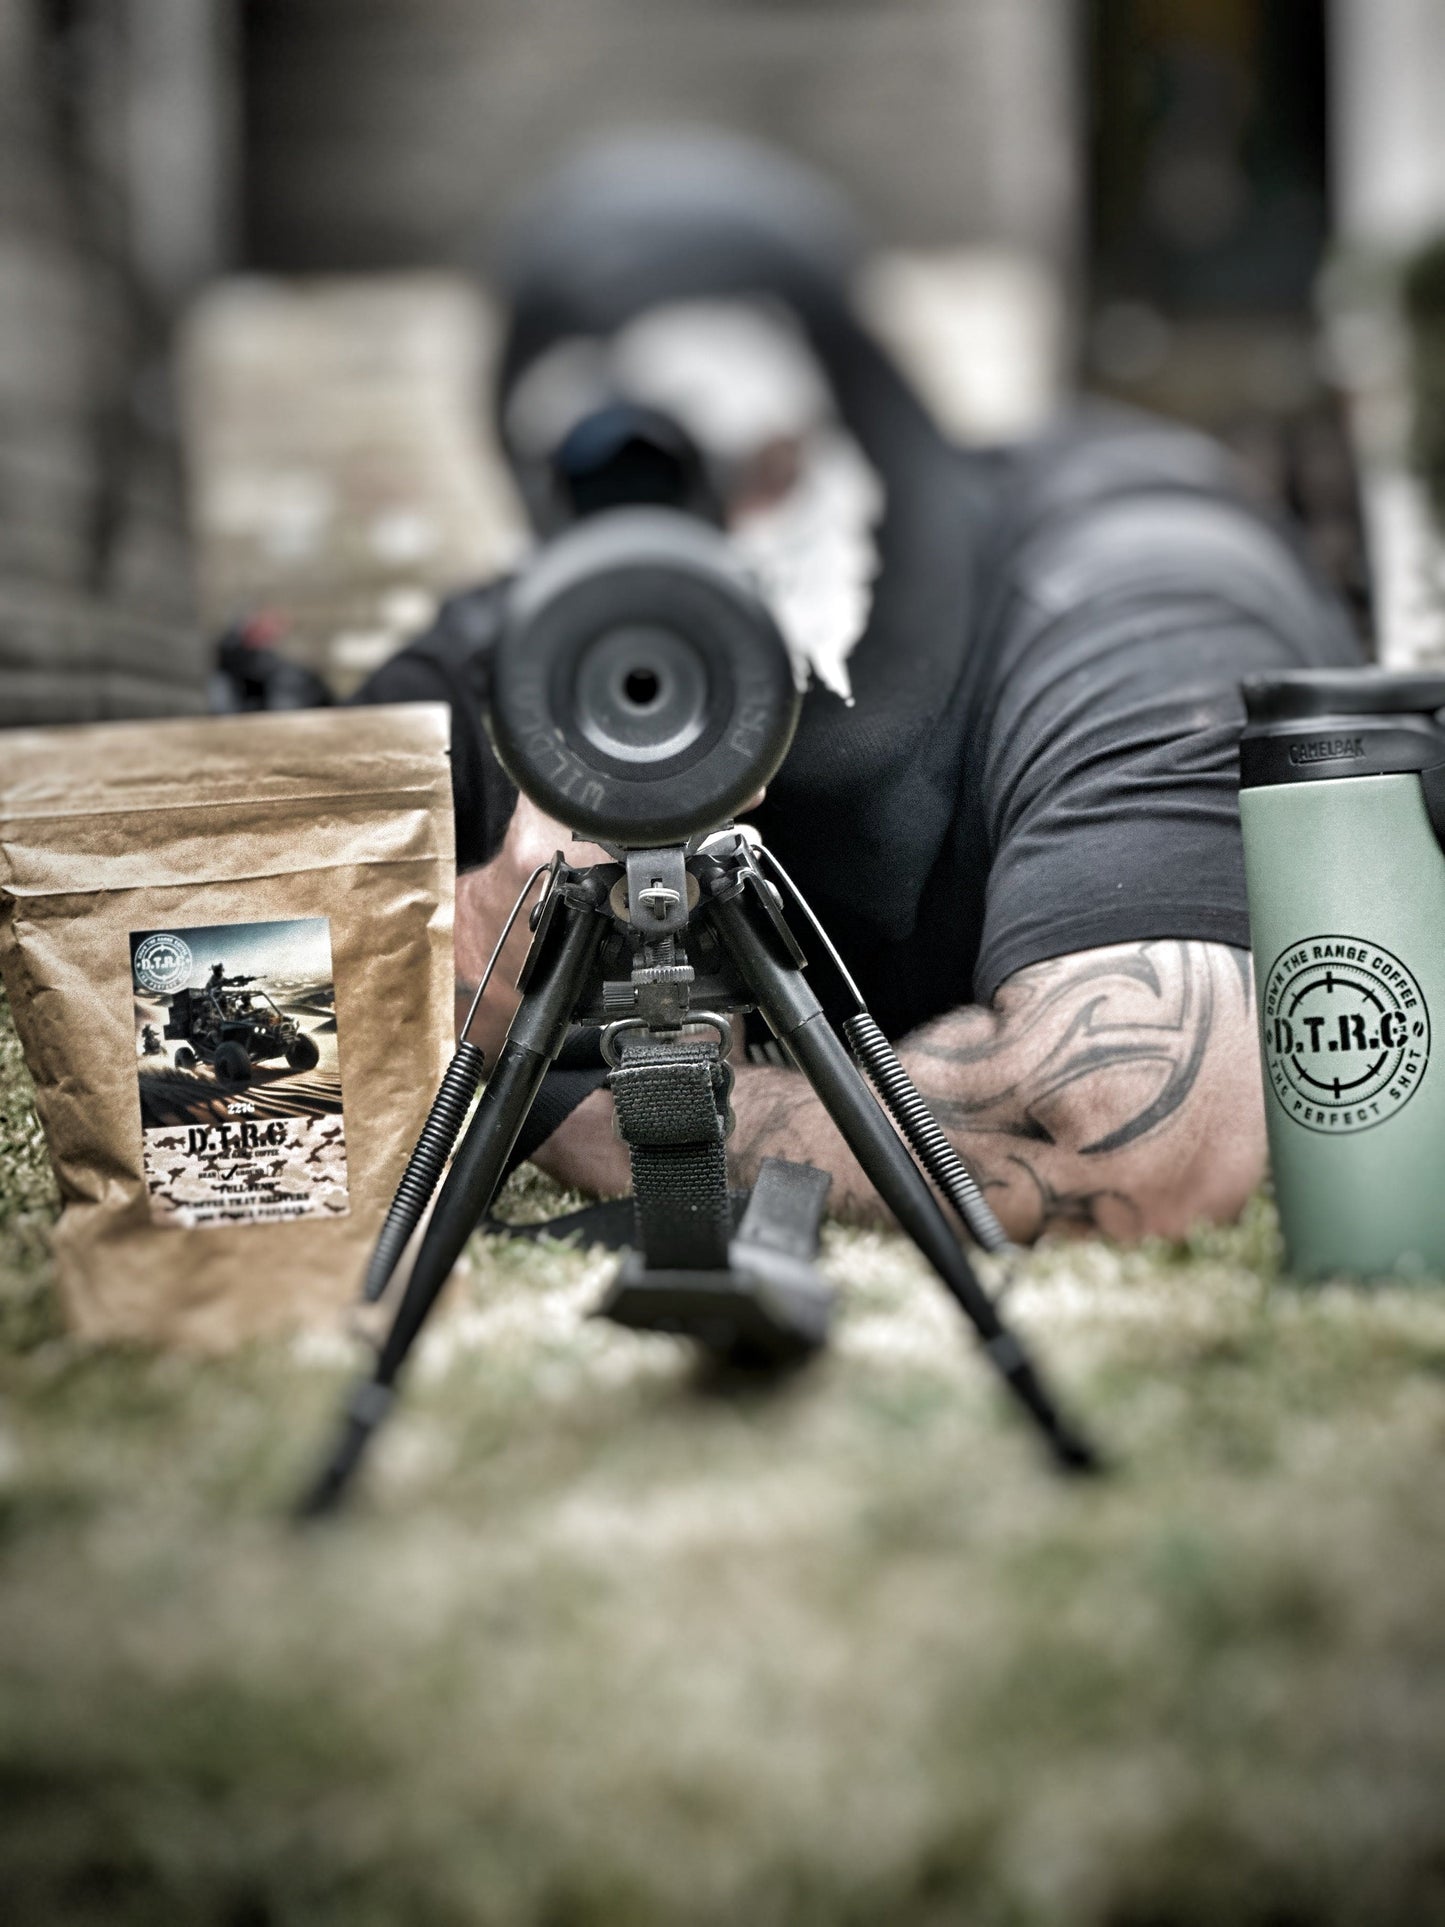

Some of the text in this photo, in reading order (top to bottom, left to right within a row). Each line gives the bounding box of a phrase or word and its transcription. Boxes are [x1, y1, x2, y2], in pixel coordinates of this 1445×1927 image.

[1289, 738, 1366, 764] CAMELBAK
[1267, 945, 1418, 1016] DOWN THE RANGE COFFEE
[1271, 1050, 1422, 1126] THE PERFECT SHOT
